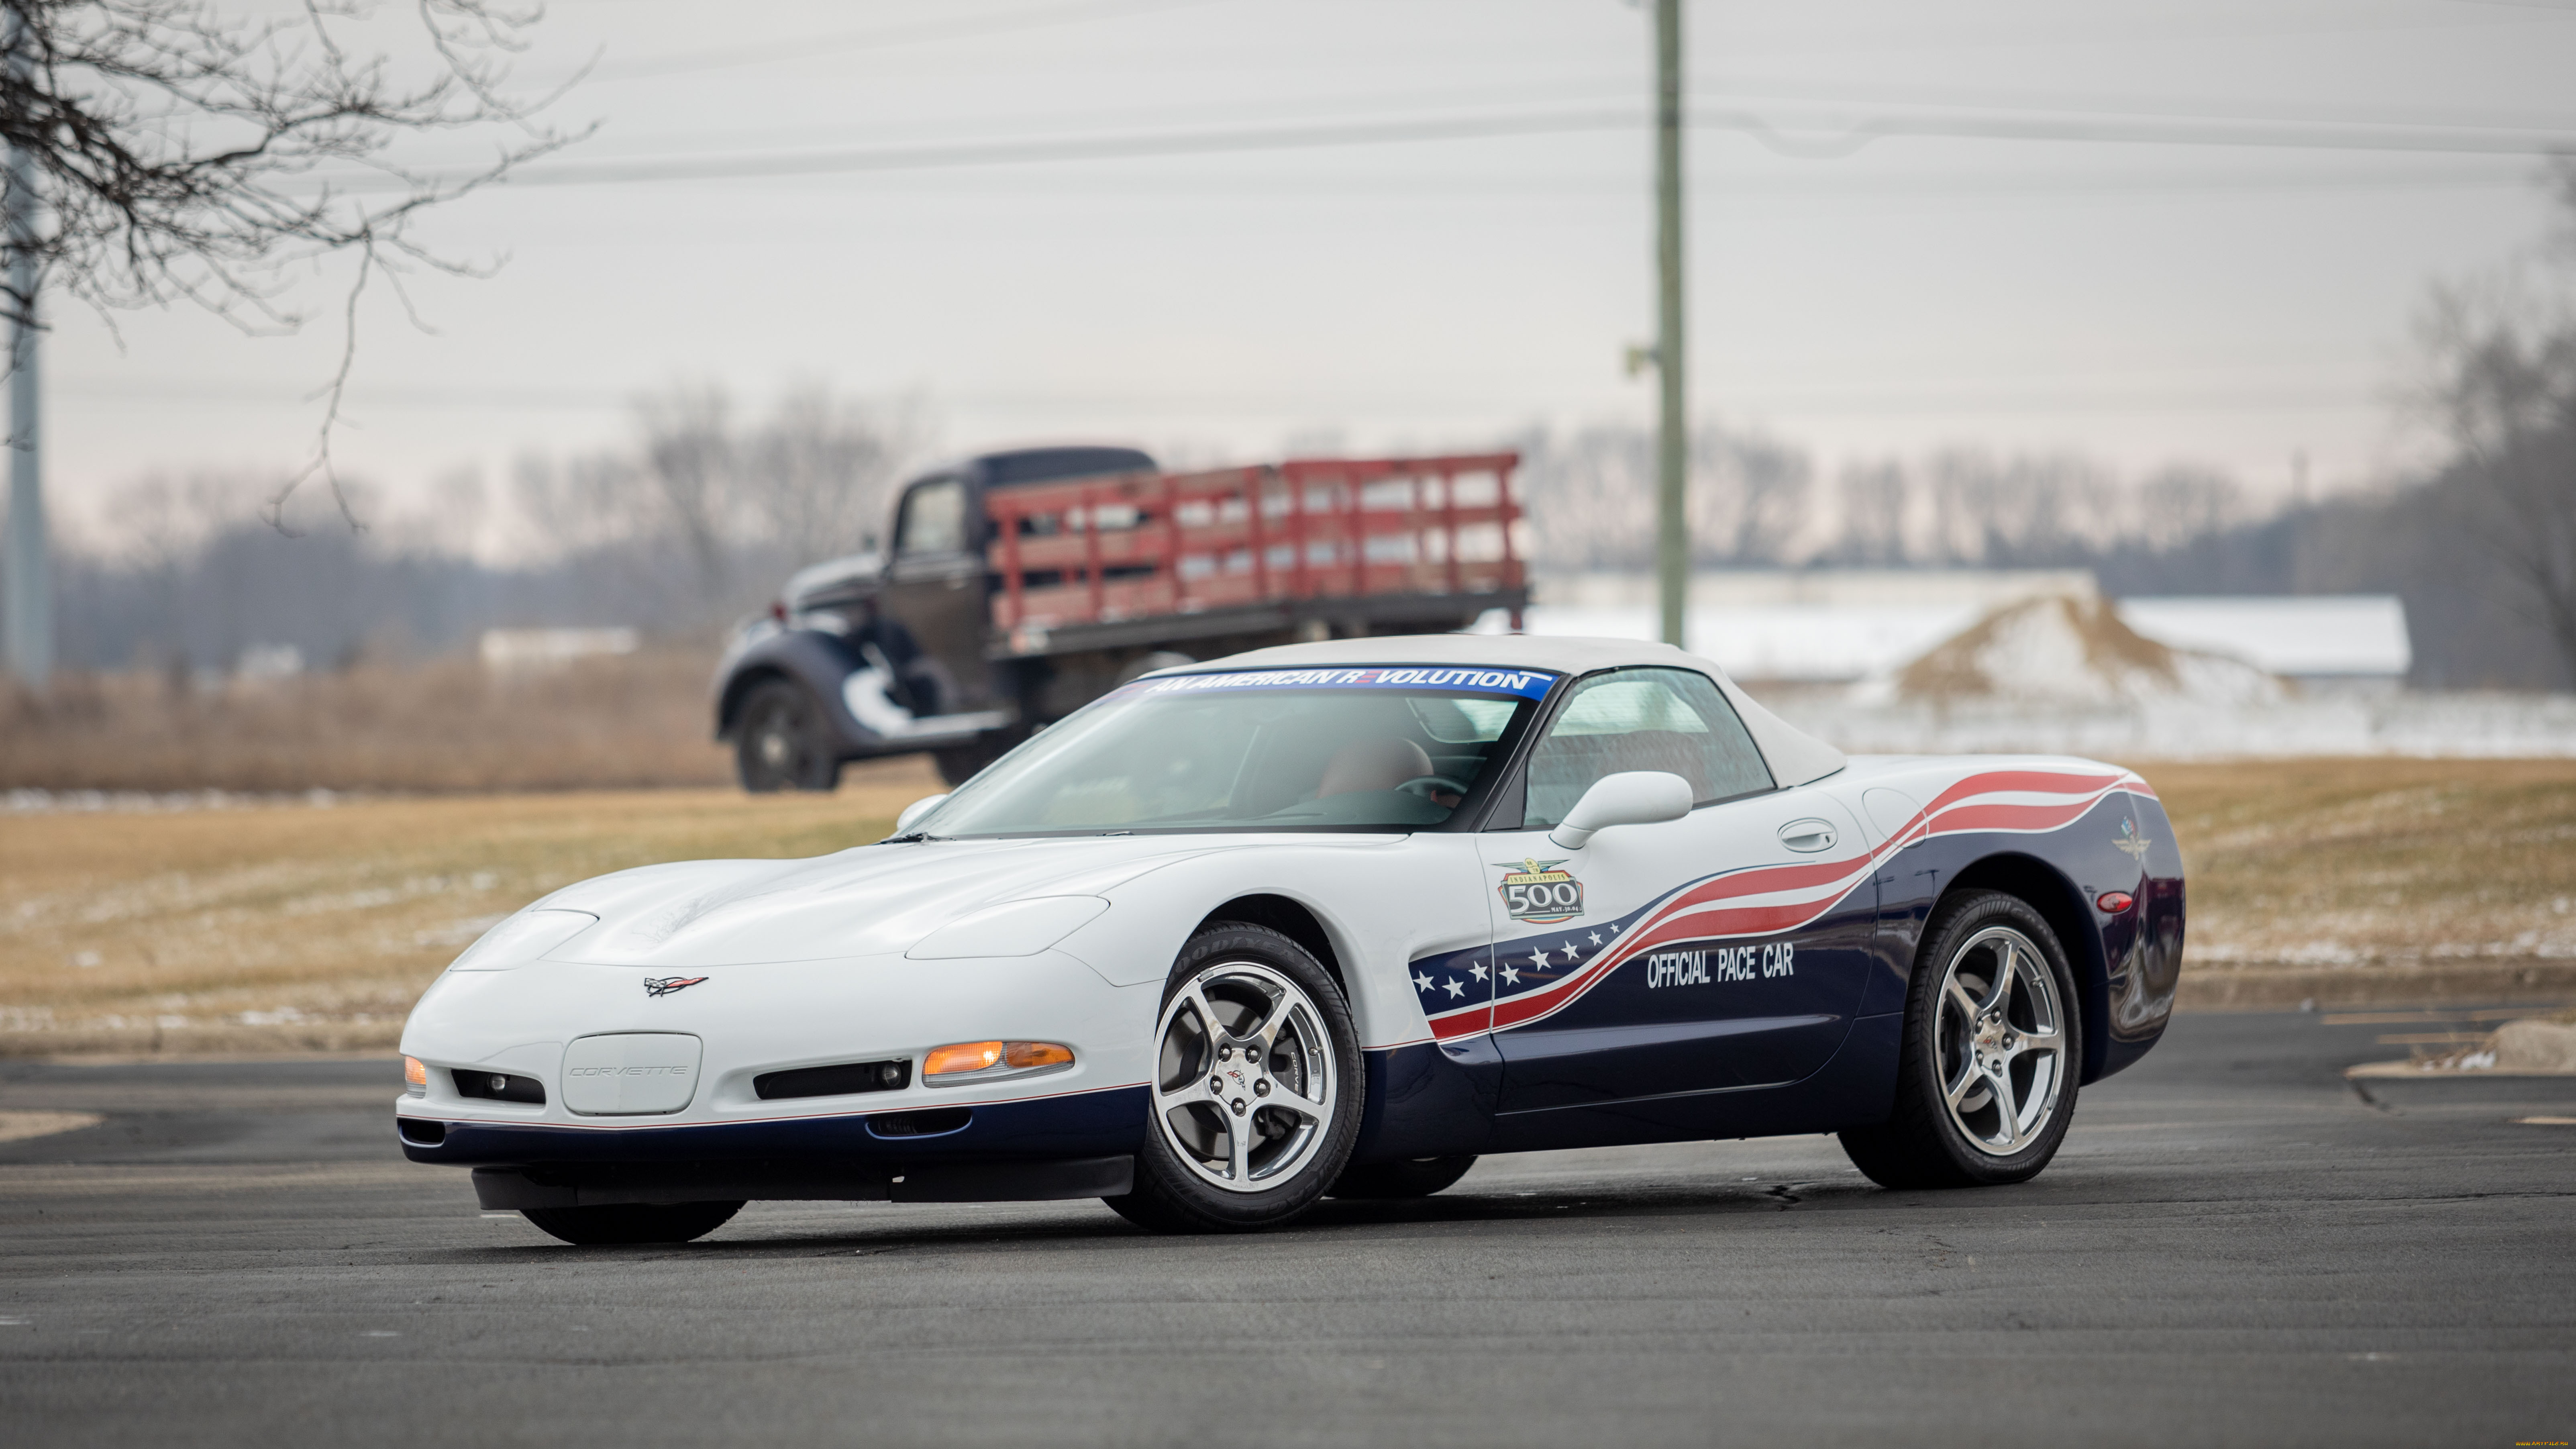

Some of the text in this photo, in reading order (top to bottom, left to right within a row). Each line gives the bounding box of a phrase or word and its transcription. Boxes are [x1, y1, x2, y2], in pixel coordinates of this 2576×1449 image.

[1144, 670, 1531, 693] AN AMERICAN REVOLUTION
[1510, 874, 1565, 883] INDIANAPOLIS
[1508, 883, 1578, 915] 500
[1647, 942, 1794, 989] OFFICIAL PACE CAR
[569, 1066, 688, 1077] CORVETTE
